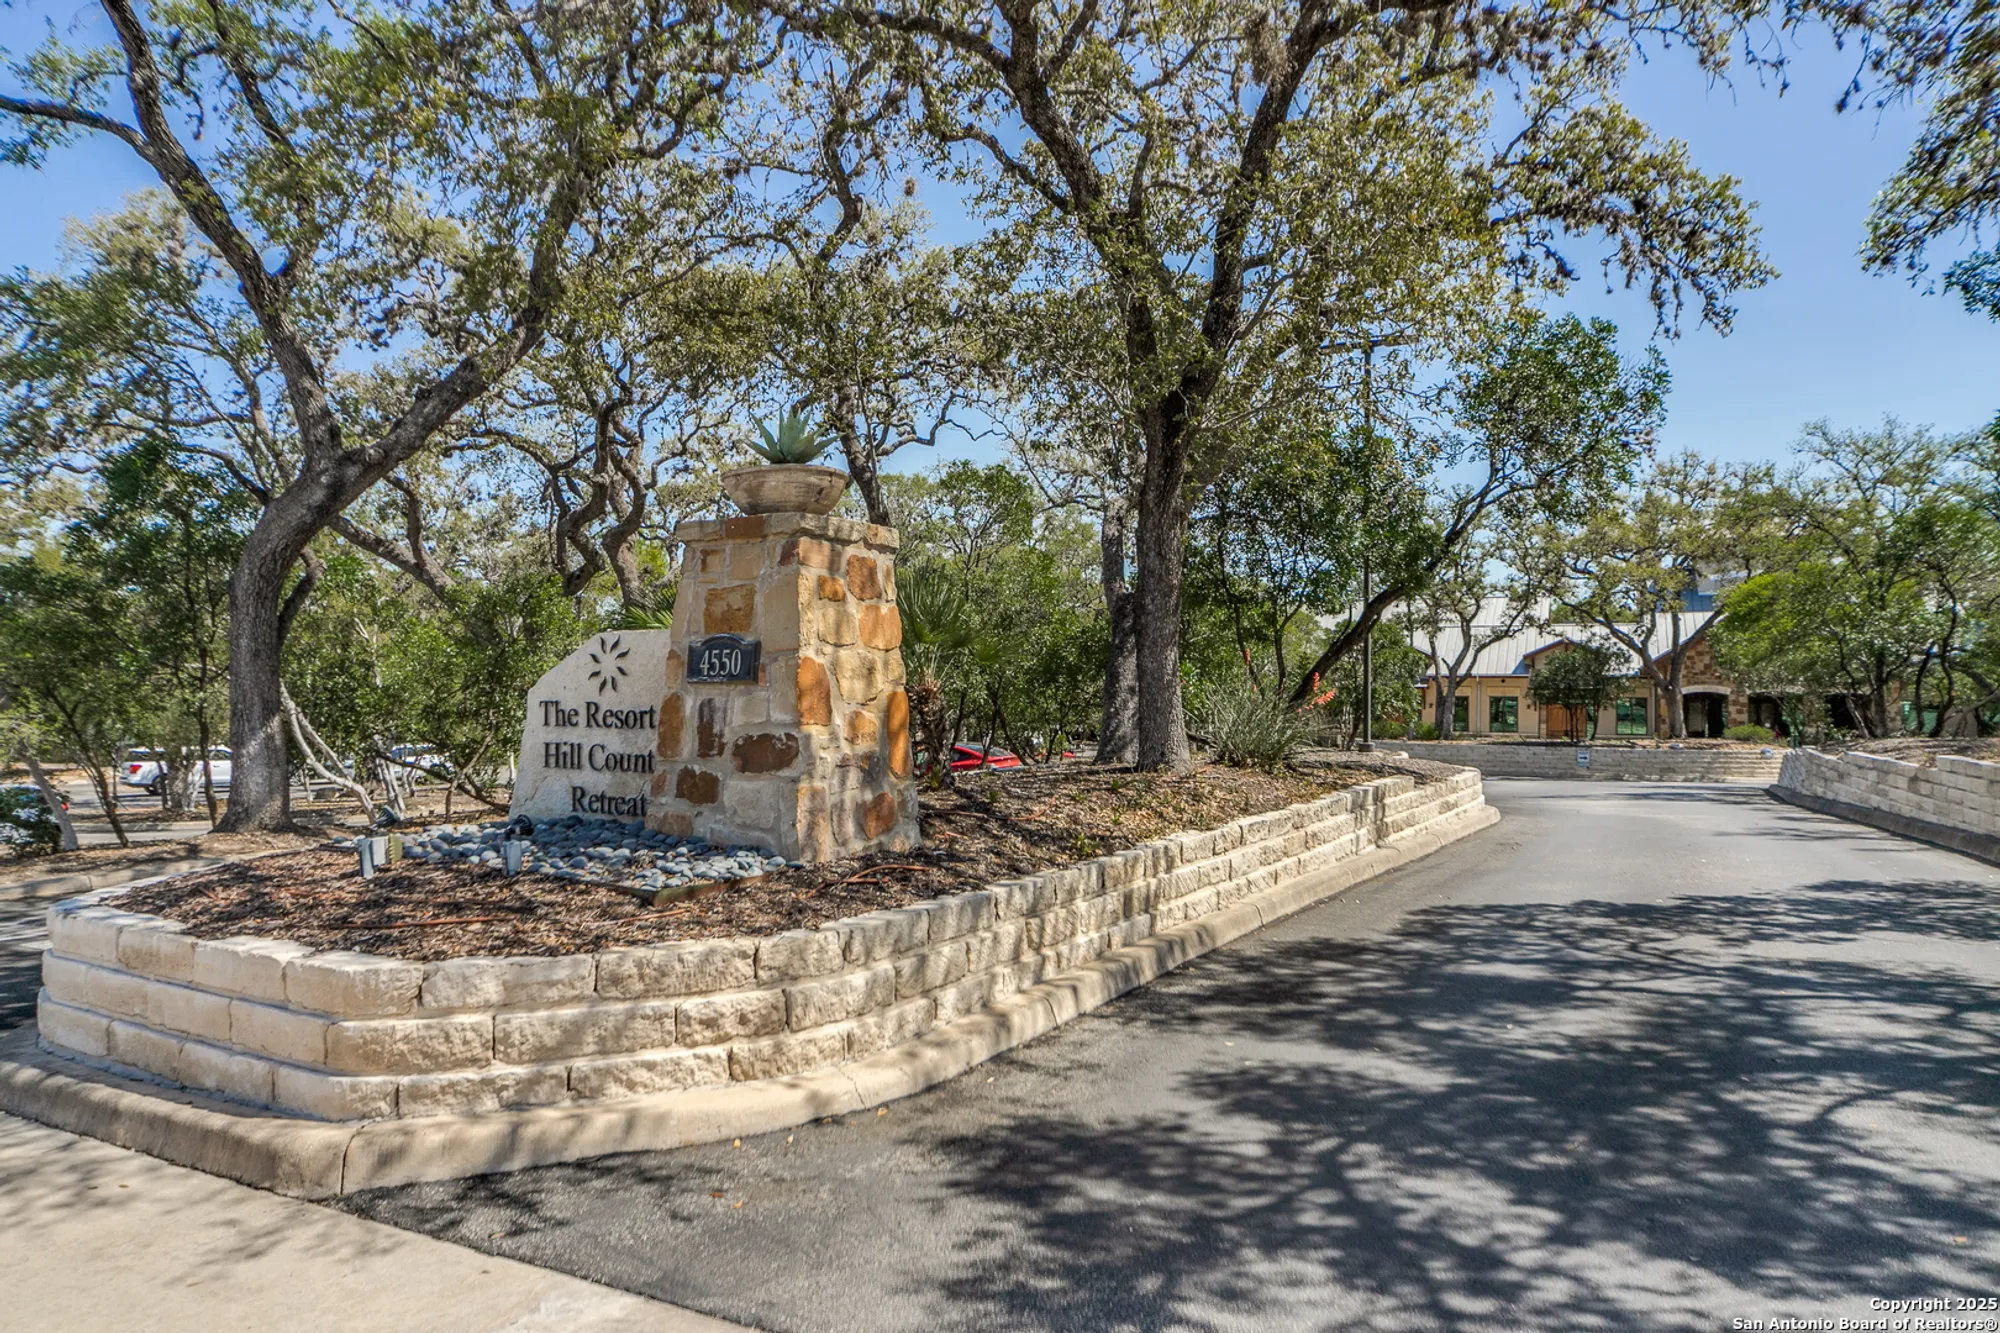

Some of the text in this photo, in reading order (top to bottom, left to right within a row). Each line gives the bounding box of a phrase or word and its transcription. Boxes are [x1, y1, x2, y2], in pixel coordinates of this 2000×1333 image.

[700, 649, 741, 676] 4550
[539, 700, 656, 730] The Resort
[543, 742, 583, 770] Hill
[571, 786, 647, 817] Retreat
